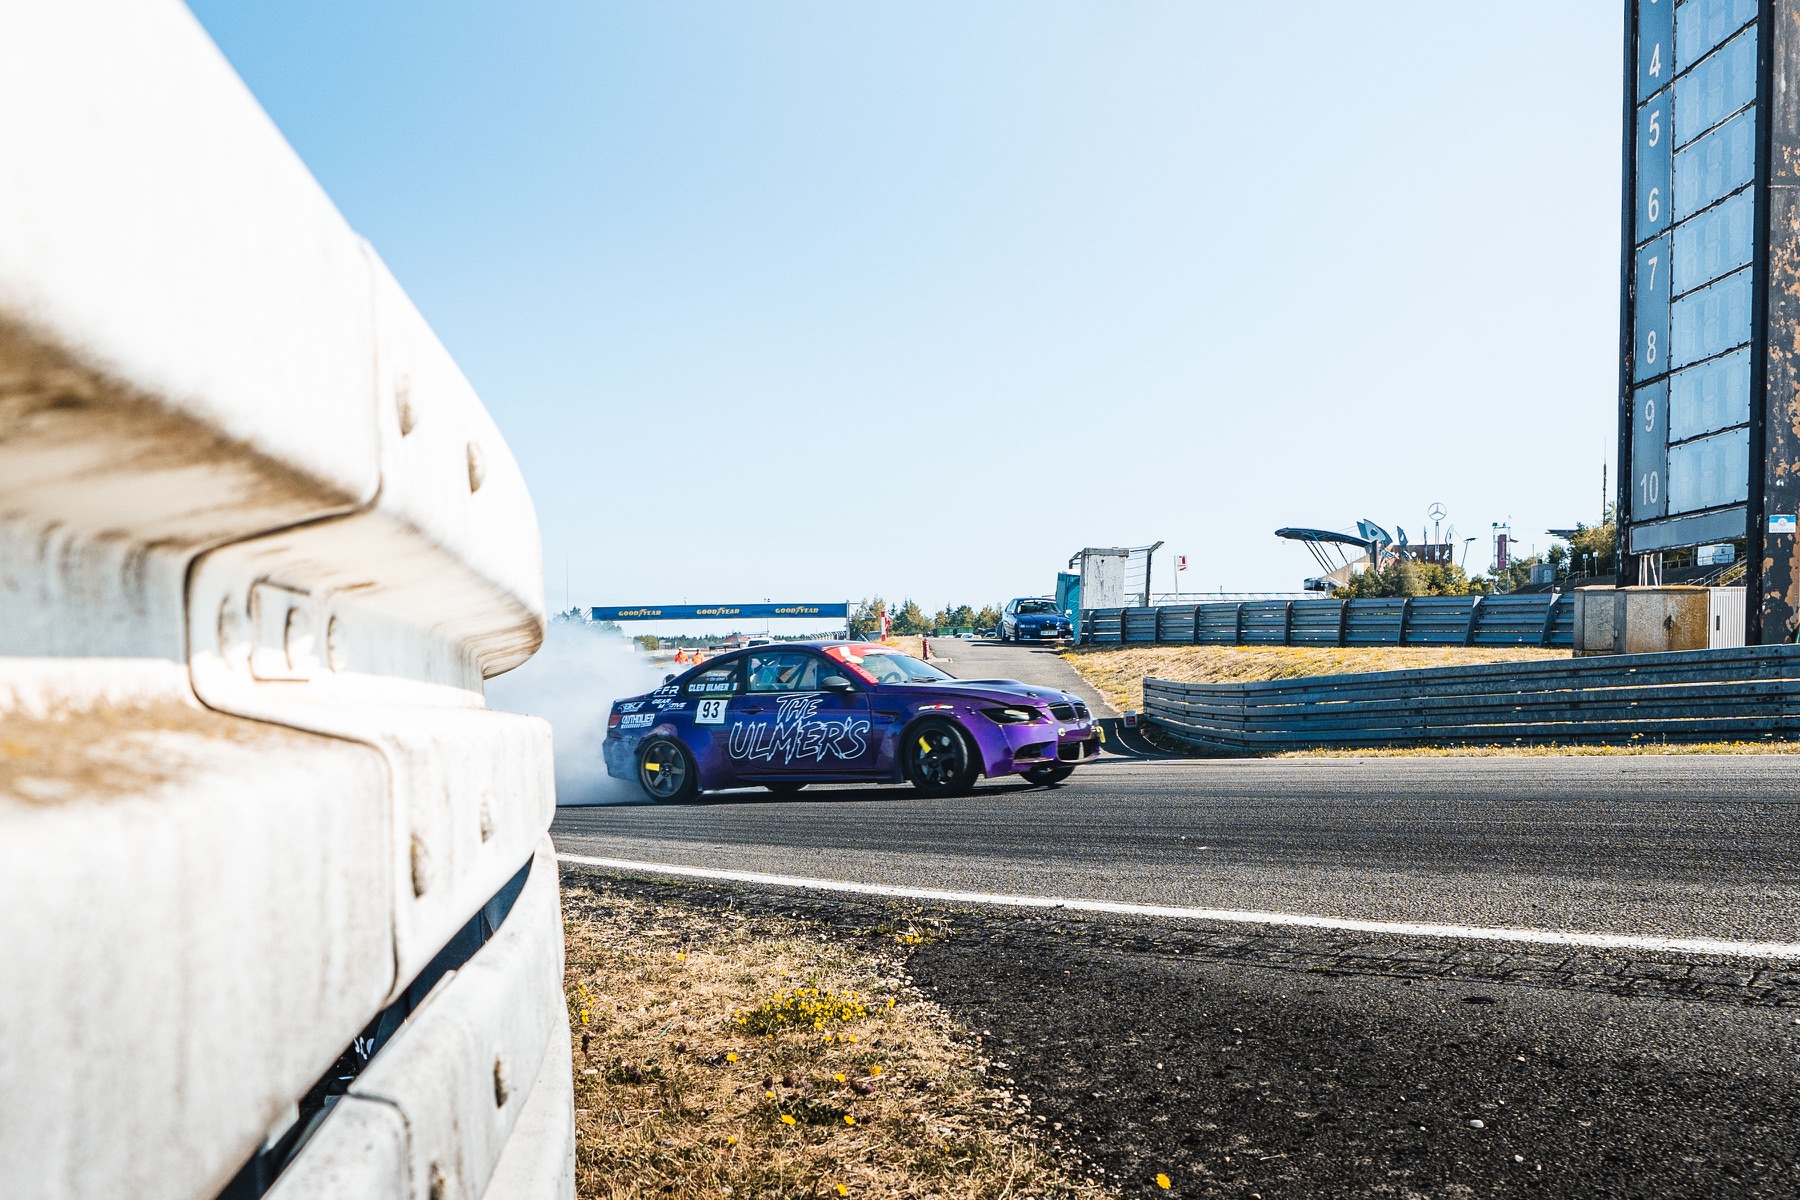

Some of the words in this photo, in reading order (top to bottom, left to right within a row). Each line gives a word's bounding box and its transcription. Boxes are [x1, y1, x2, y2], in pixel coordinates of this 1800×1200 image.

[1649, 42, 1661, 78] 4
[1648, 110, 1660, 147] 5
[1648, 187, 1659, 223] 6
[1648, 256, 1658, 291] 7
[1646, 330, 1657, 365] 8
[1644, 399, 1655, 433] 9
[1640, 470, 1659, 506] 10
[618, 608, 662, 617] GOODYEAR
[696, 607, 740, 616] GOODYEAR
[775, 606, 819, 615] GOODYEAR
[654, 686, 679, 694] FFR
[706, 683, 729, 691] ULMER
[702, 701, 720, 719] 93
[776, 693, 824, 724] THE
[728, 716, 871, 765] ULMER'S
